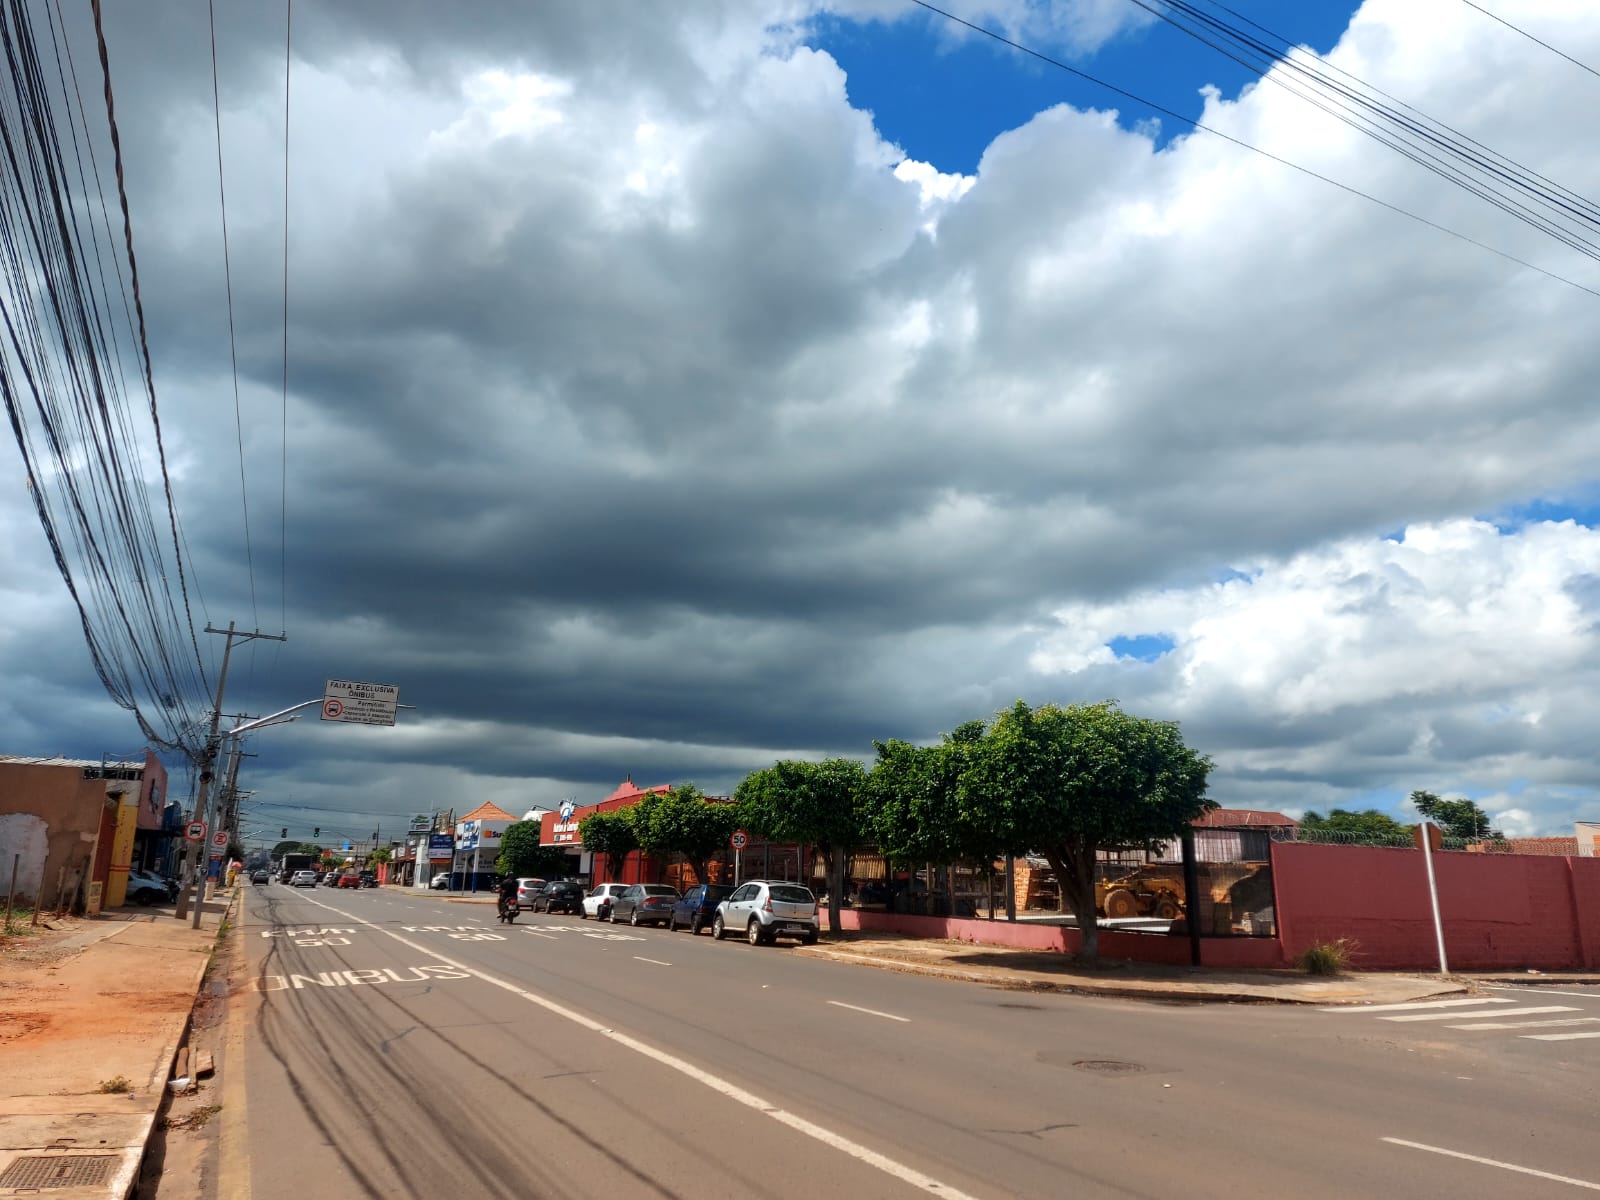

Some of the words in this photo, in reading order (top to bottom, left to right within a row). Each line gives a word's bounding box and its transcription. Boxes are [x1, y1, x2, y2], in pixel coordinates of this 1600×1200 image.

[330, 682, 352, 690] FAIXA
[356, 685, 394, 694] EXCLUSIVA
[733, 835, 745, 843] 50
[295, 937, 352, 947] 50
[447, 933, 508, 942] 50
